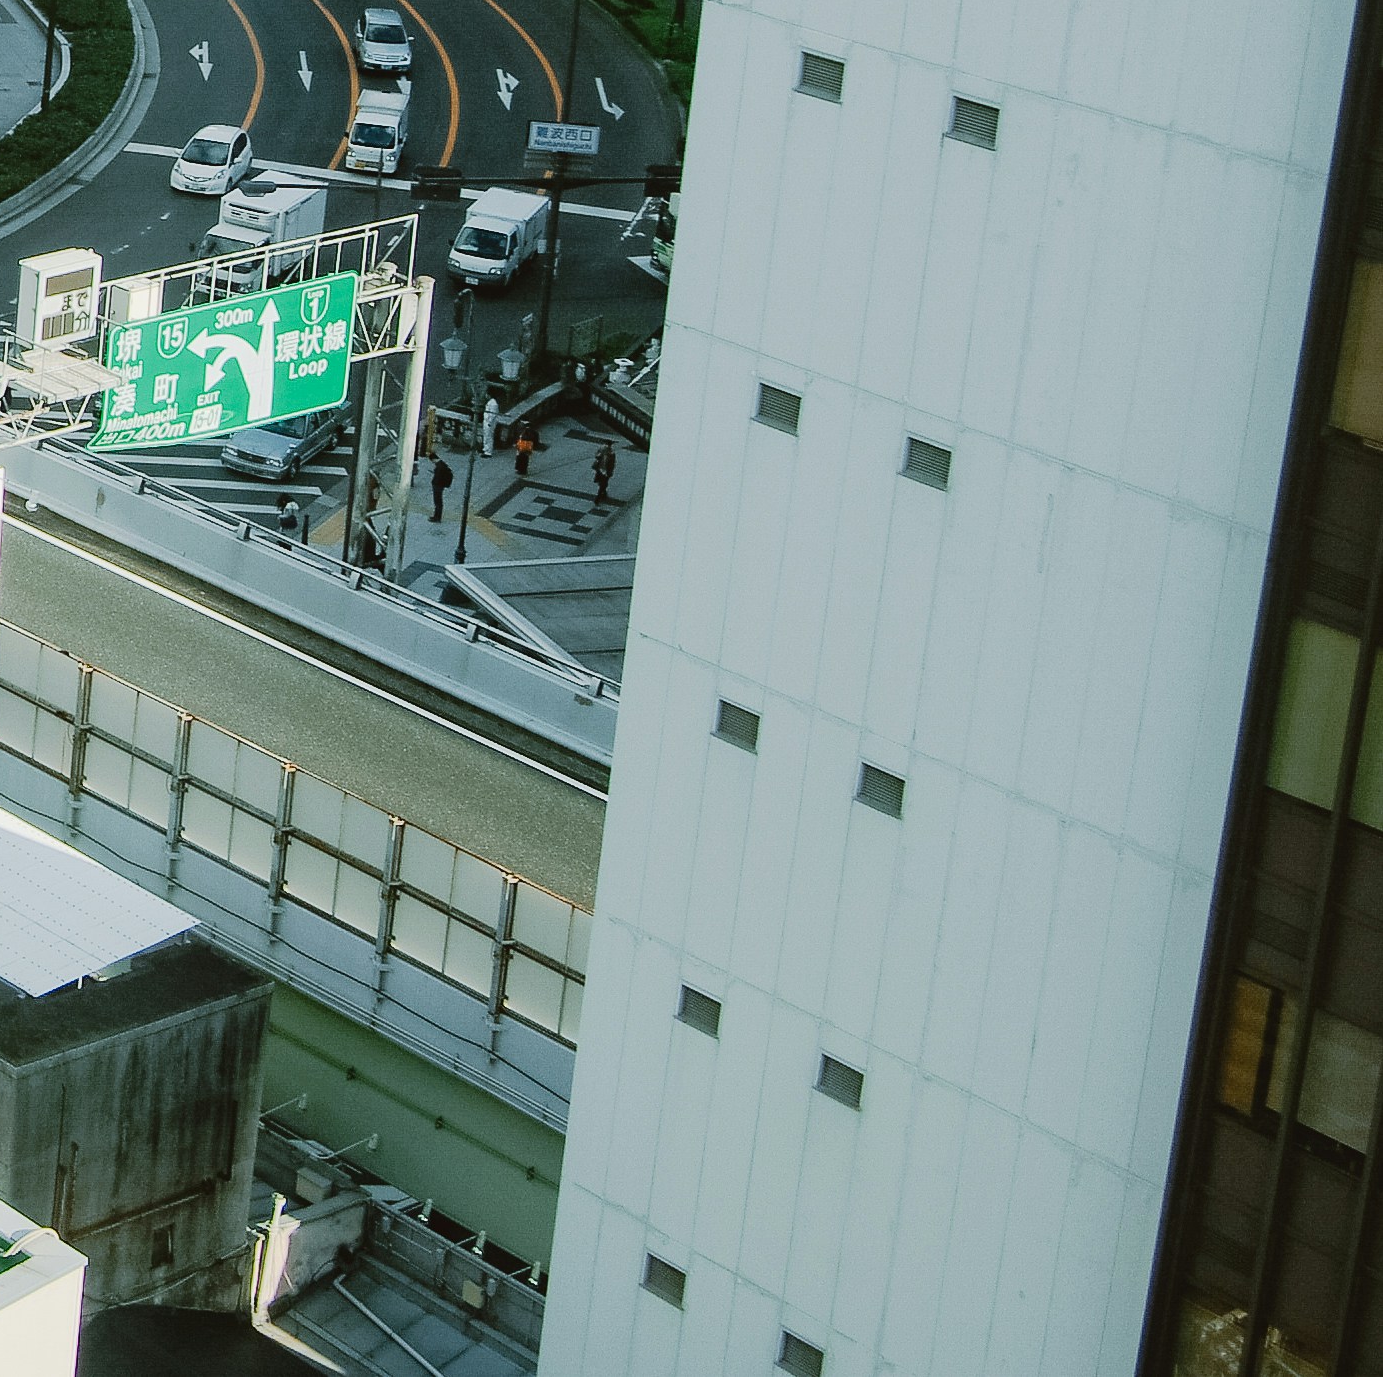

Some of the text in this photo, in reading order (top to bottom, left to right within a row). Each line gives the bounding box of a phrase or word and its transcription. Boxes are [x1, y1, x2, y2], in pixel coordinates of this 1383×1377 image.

[536, 125, 593, 141] 難波西口
[61, 292, 88, 312] まで
[309, 296, 320, 320] 1
[214, 308, 254, 330] 300m
[114, 328, 143, 363] 堺
[161, 324, 184, 350] 15
[274, 319, 348, 362] 環状線
[288, 359, 329, 380] Loop
[196, 390, 221, 406] EXIT
[107, 403, 179, 433] Minatomachi
